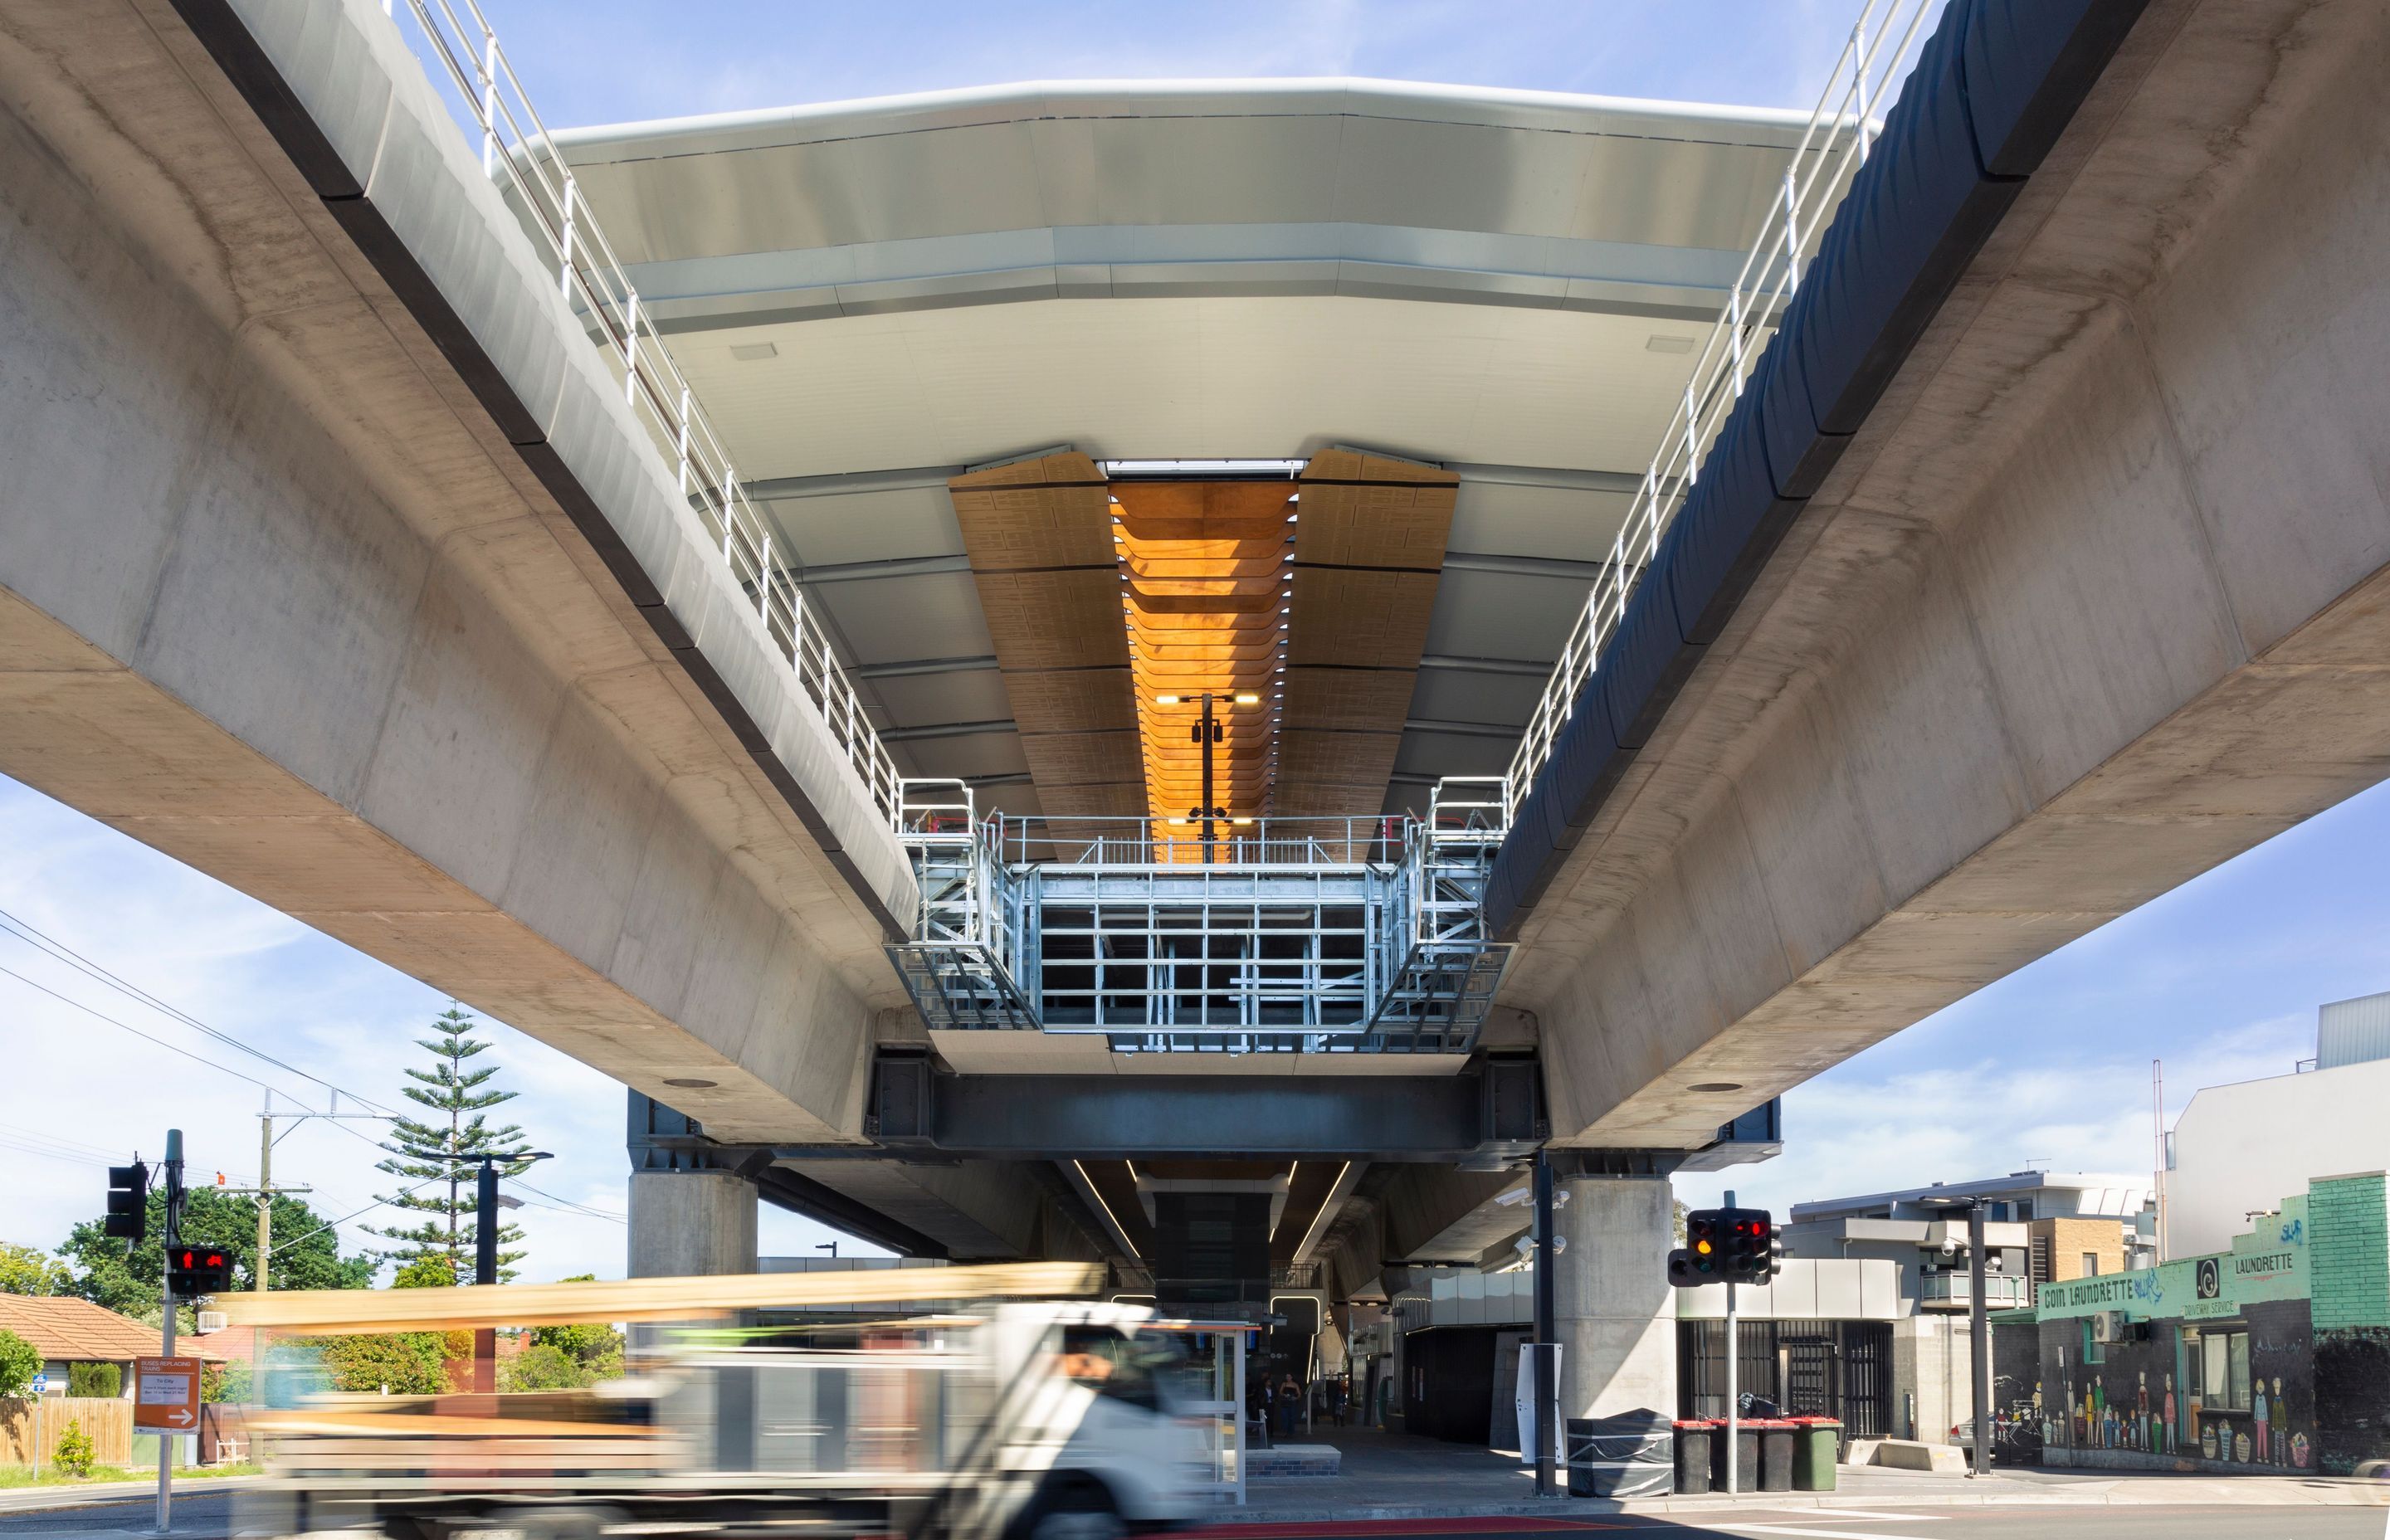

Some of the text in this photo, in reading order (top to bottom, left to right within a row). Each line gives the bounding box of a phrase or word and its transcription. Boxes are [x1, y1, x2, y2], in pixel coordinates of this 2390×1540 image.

[2236, 1253, 2293, 1274] LAUNDRETTE
[2045, 1288, 2066, 1309] COIN
[2070, 1279, 2133, 1306] LAUNDRETTE
[2184, 1300, 2234, 1317] DRIVEWAY SERVICE
